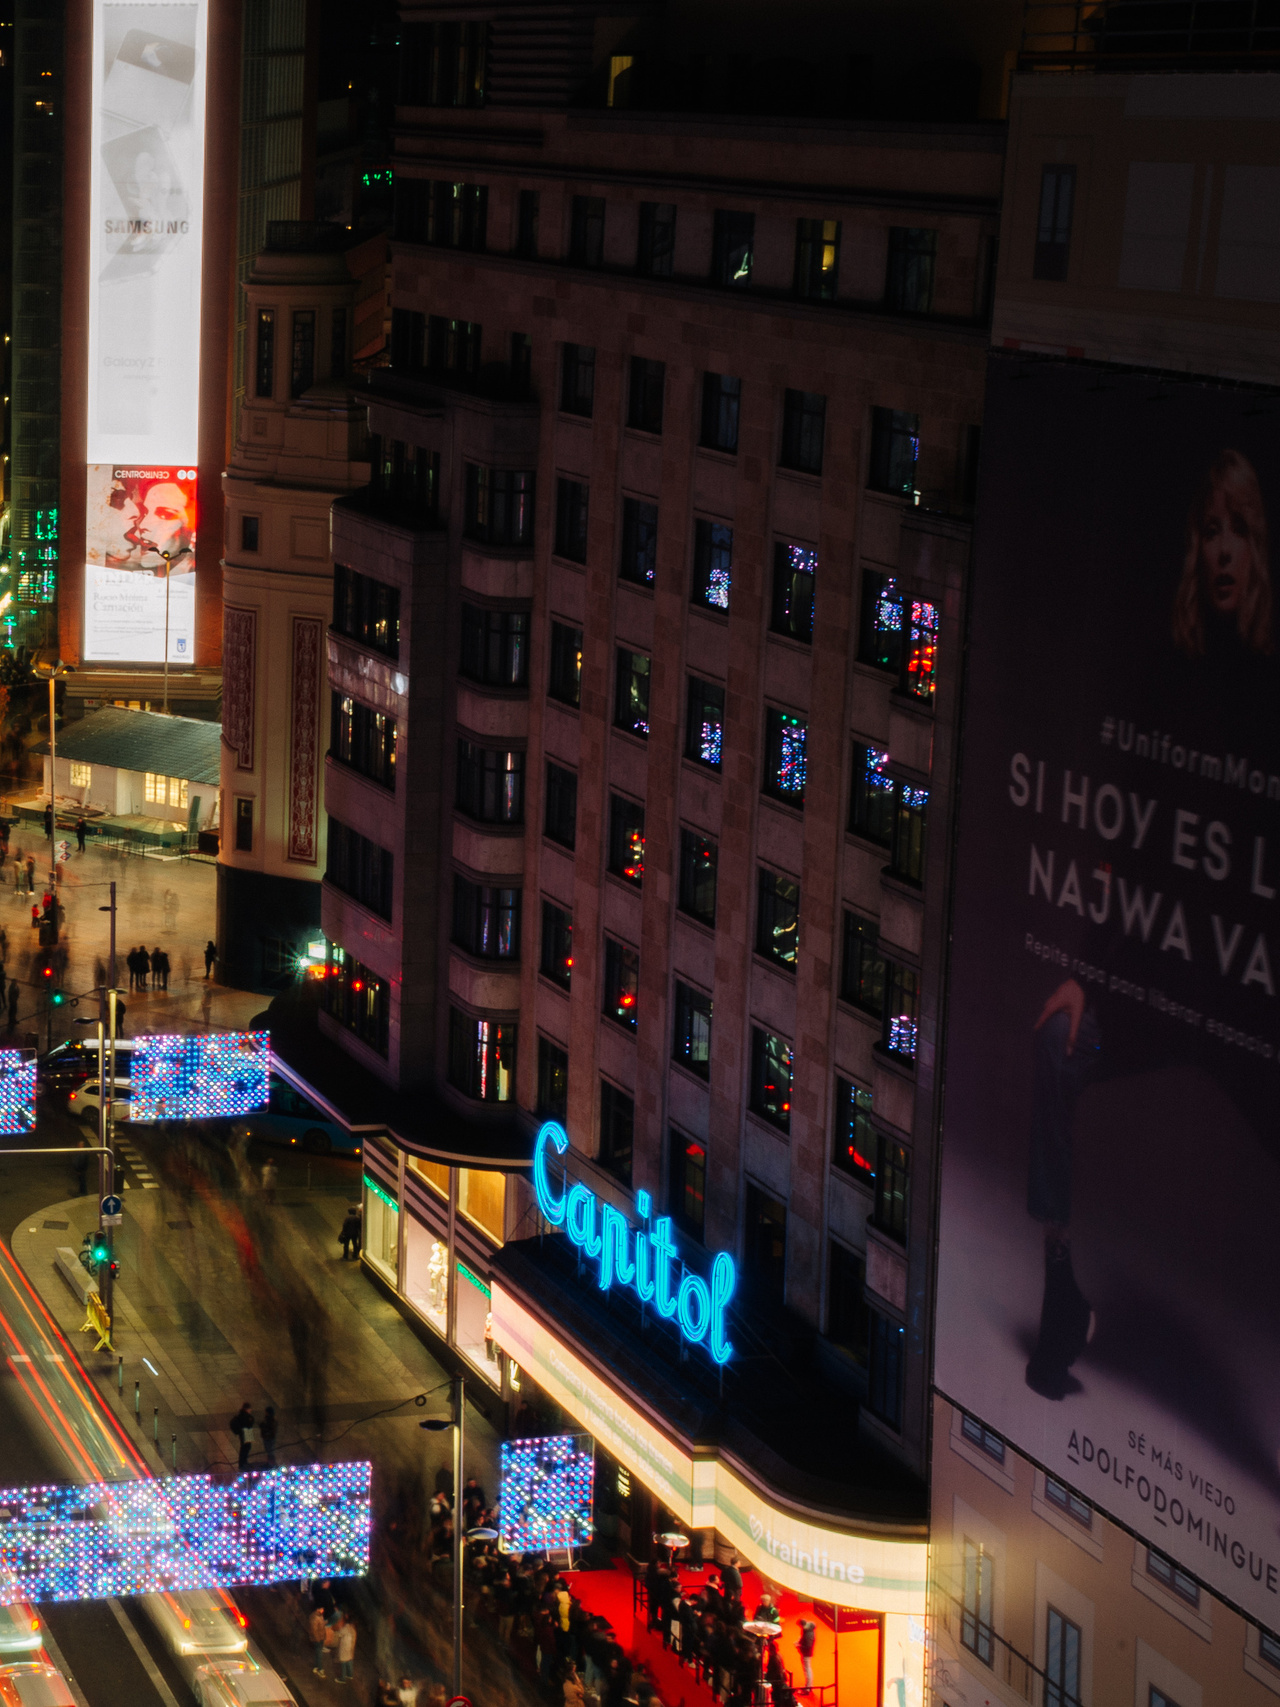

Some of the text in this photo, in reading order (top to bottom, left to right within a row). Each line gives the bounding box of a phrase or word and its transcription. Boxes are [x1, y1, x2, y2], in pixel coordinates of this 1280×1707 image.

[104, 220, 190, 235] SAMSUNG
[103, 356, 147, 370] Galaxy
[1009, 752, 1045, 814] SI
[1061, 769, 1157, 850] HOY
[1172, 808, 1233, 882] ES
[1028, 842, 1276, 997] NAJWA VA
[1024, 932, 1070, 967] Repite
[1072, 957, 1106, 984] ropa
[1109, 974, 1146, 1001] para
[1149, 987, 1202, 1027] liberar
[533, 1120, 736, 1365] Capitol
[1127, 1430, 1235, 1516] SÉ MÁS VIEJO
[766, 1530, 865, 1584] trainline
